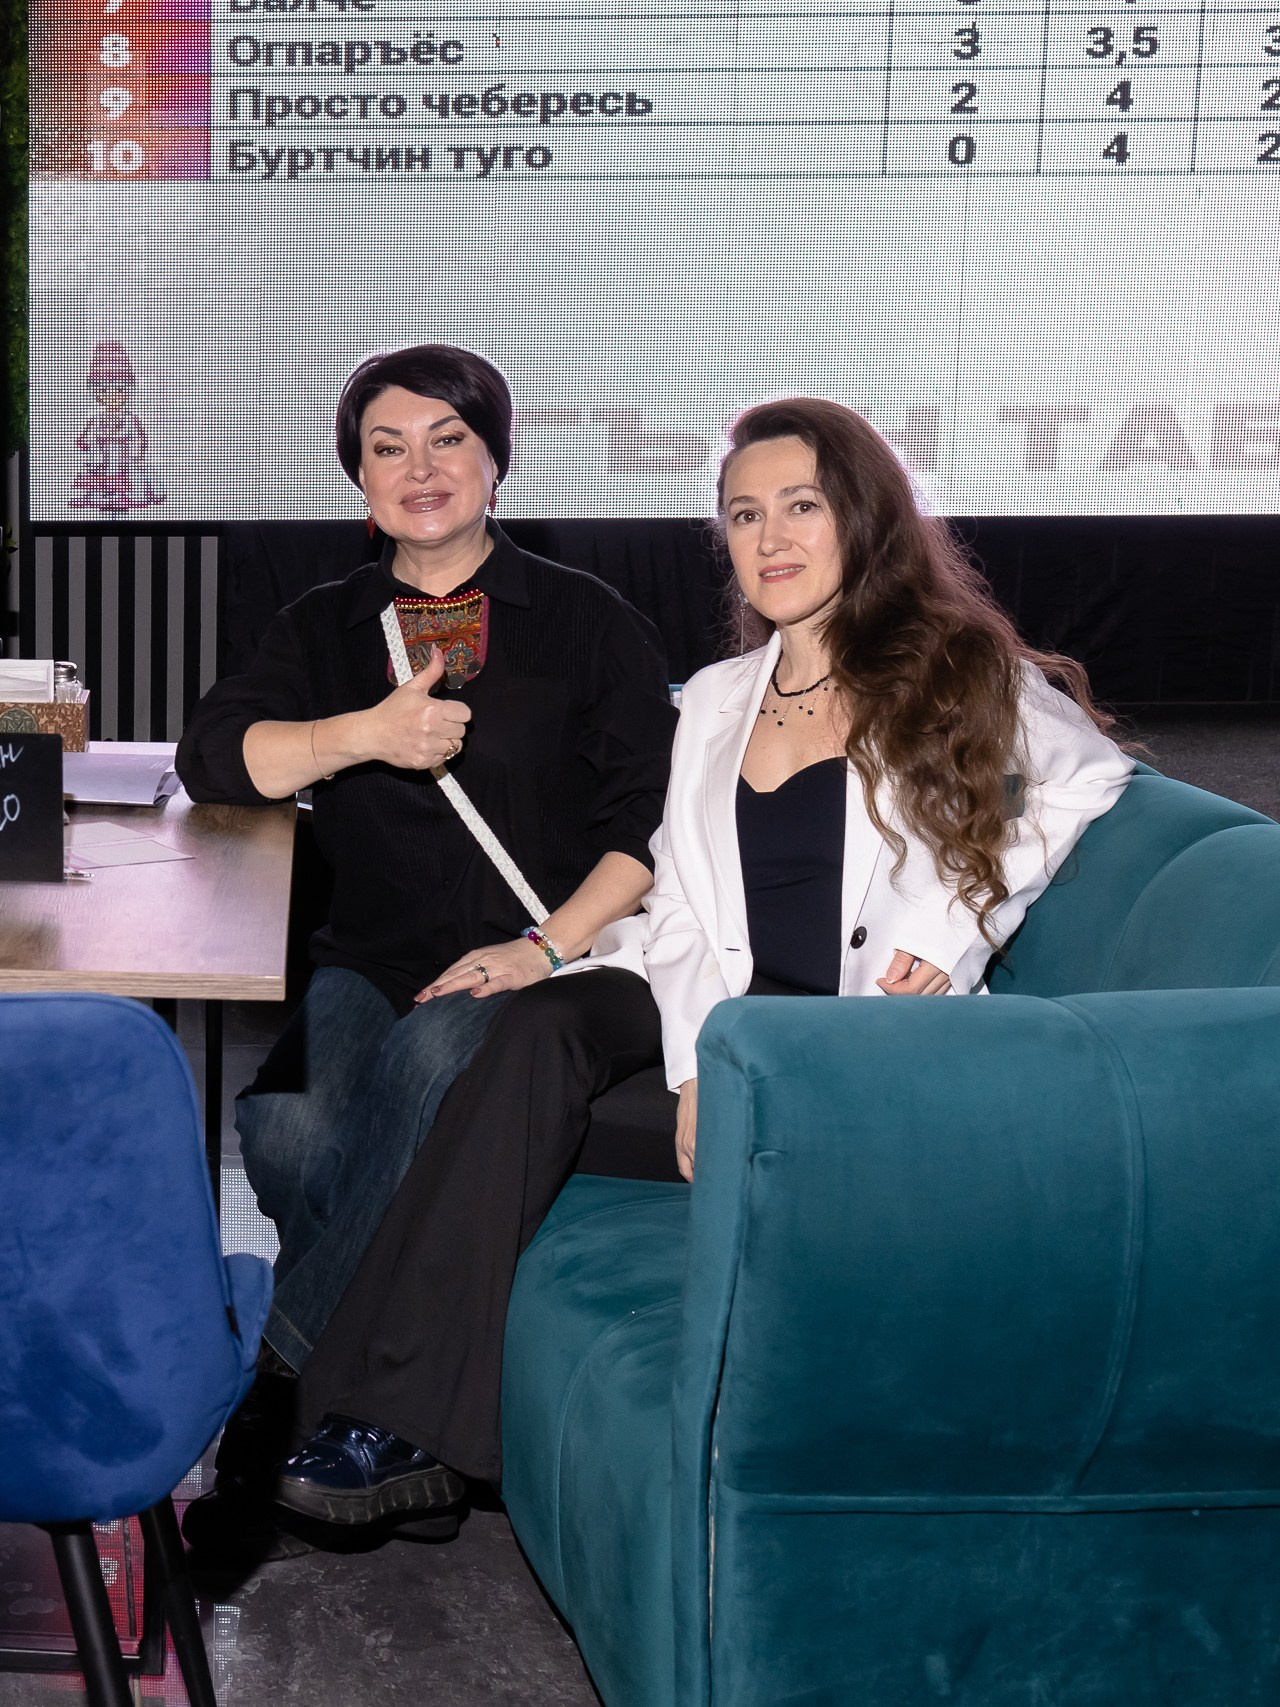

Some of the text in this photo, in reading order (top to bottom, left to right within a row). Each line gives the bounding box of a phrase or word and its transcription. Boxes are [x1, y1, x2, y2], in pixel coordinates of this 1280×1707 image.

[100, 33, 131, 67] 8
[229, 32, 464, 73] Огпаръёс
[953, 29, 982, 60] 3
[1086, 26, 1160, 66] 3,5
[100, 87, 132, 119] 9
[229, 88, 407, 127] Просто
[422, 83, 654, 125] чебересь
[951, 82, 979, 115] 2
[1105, 78, 1133, 112] 4
[87, 132, 1280, 180] 10 Буртчин туго 0 4 2
